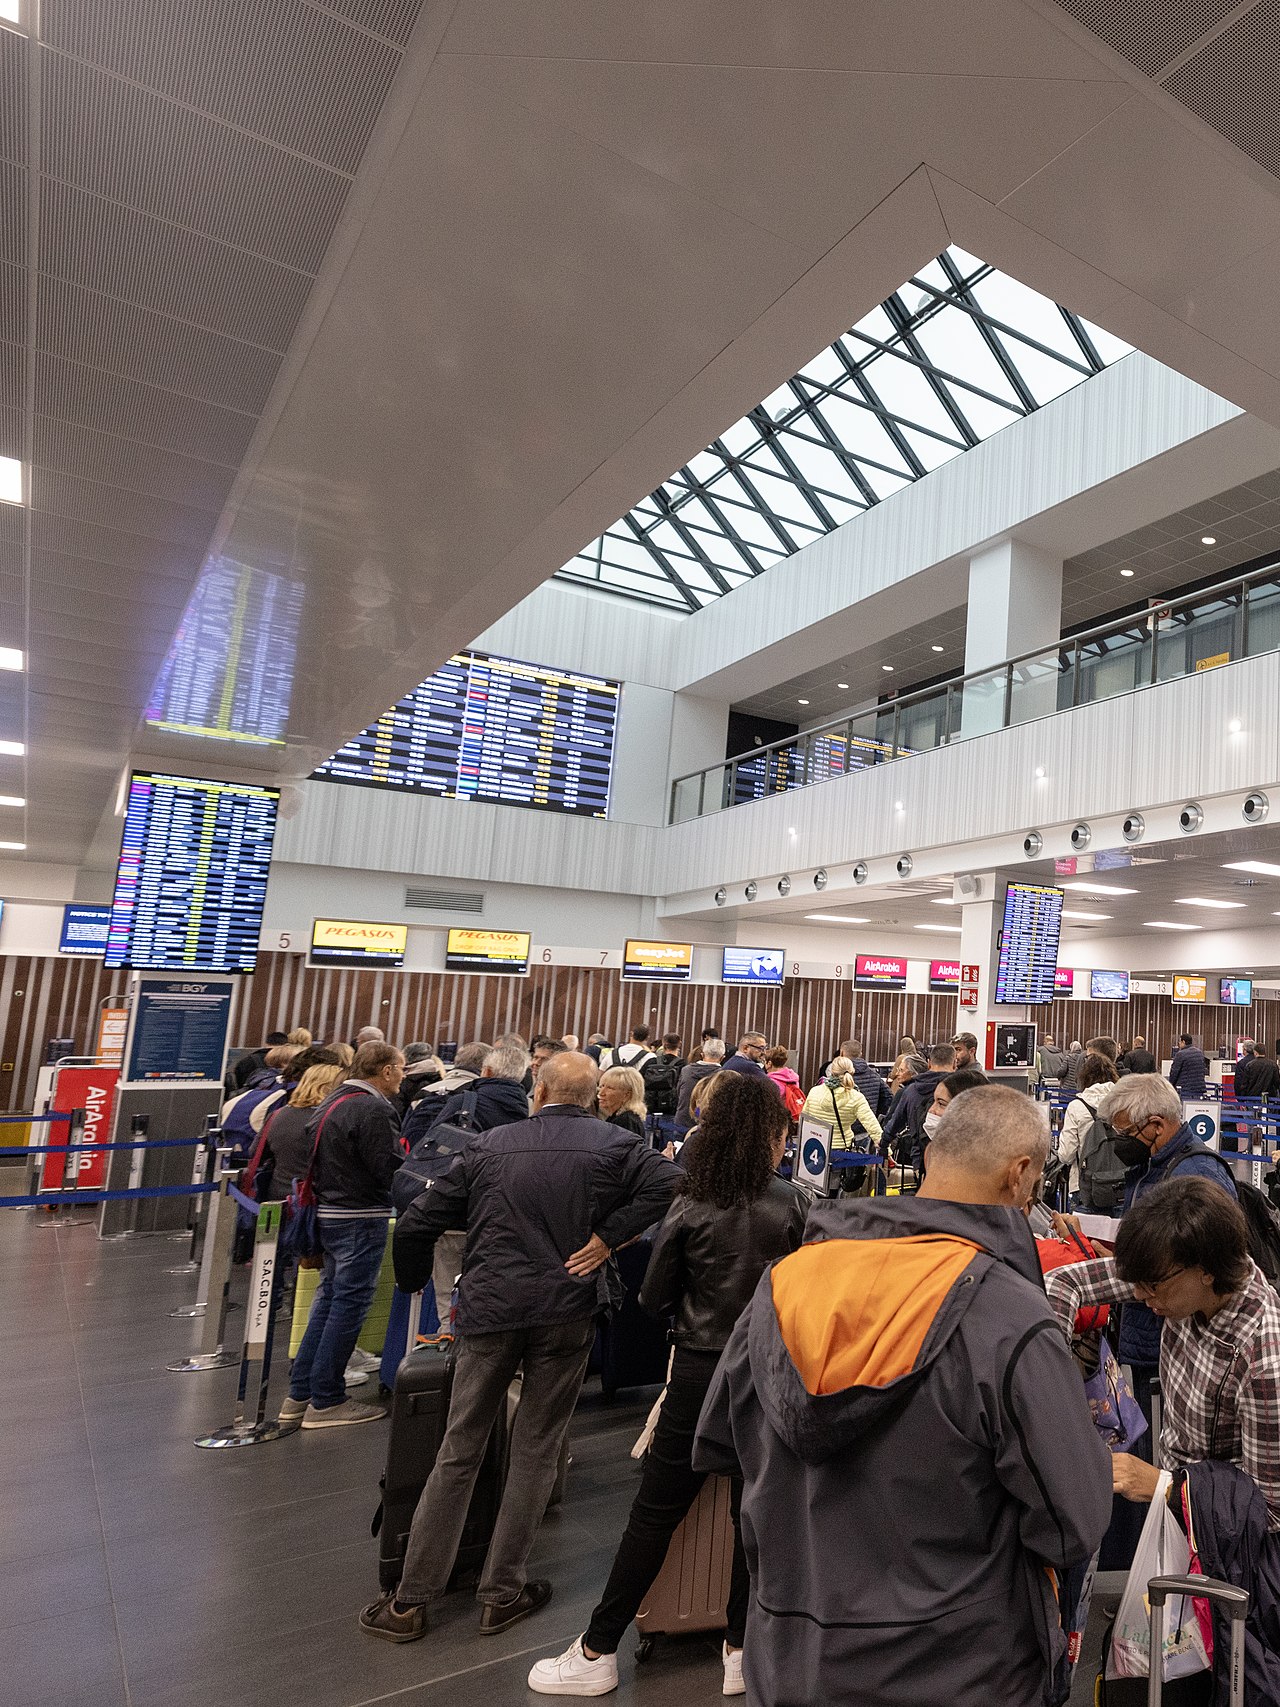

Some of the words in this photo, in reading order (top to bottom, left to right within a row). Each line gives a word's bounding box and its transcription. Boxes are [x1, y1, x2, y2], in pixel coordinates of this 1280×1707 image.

[325, 927, 396, 939] PEGASUS
[458, 931, 520, 942] PEGASUS
[279, 933, 291, 949] 5
[542, 948, 552, 963] 6
[600, 951, 609, 966] 7
[792, 963, 800, 975] 8
[835, 965, 843, 978] 9
[864, 960, 900, 973] AirArabia
[181, 984, 208, 993] BGY
[1131, 982, 1140, 992] 12
[1157, 983, 1167, 993] 13
[1196, 1122, 1207, 1135] 6
[809, 1149, 819, 1166] 4
